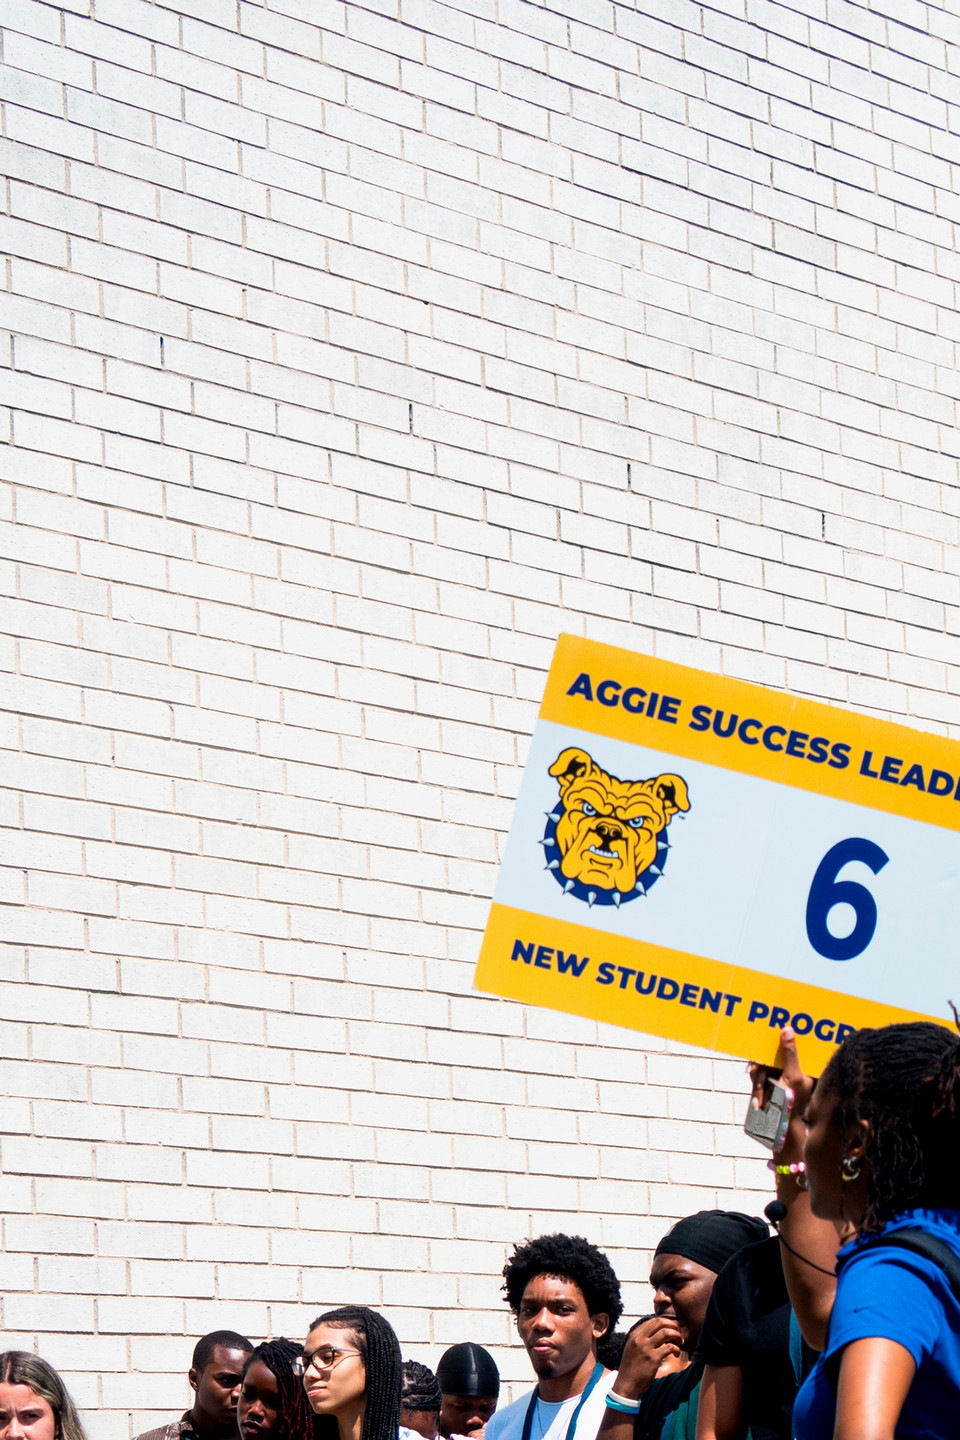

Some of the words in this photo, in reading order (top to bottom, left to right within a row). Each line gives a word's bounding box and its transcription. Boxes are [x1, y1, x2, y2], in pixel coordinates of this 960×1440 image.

[566, 673, 682, 724] AGGIE
[688, 705, 852, 769] SUCCESS
[805, 837, 890, 961] 6
[511, 939, 590, 977] NEW
[596, 962, 743, 1017] STUDENT
[747, 1000, 857, 1045] PROGR
